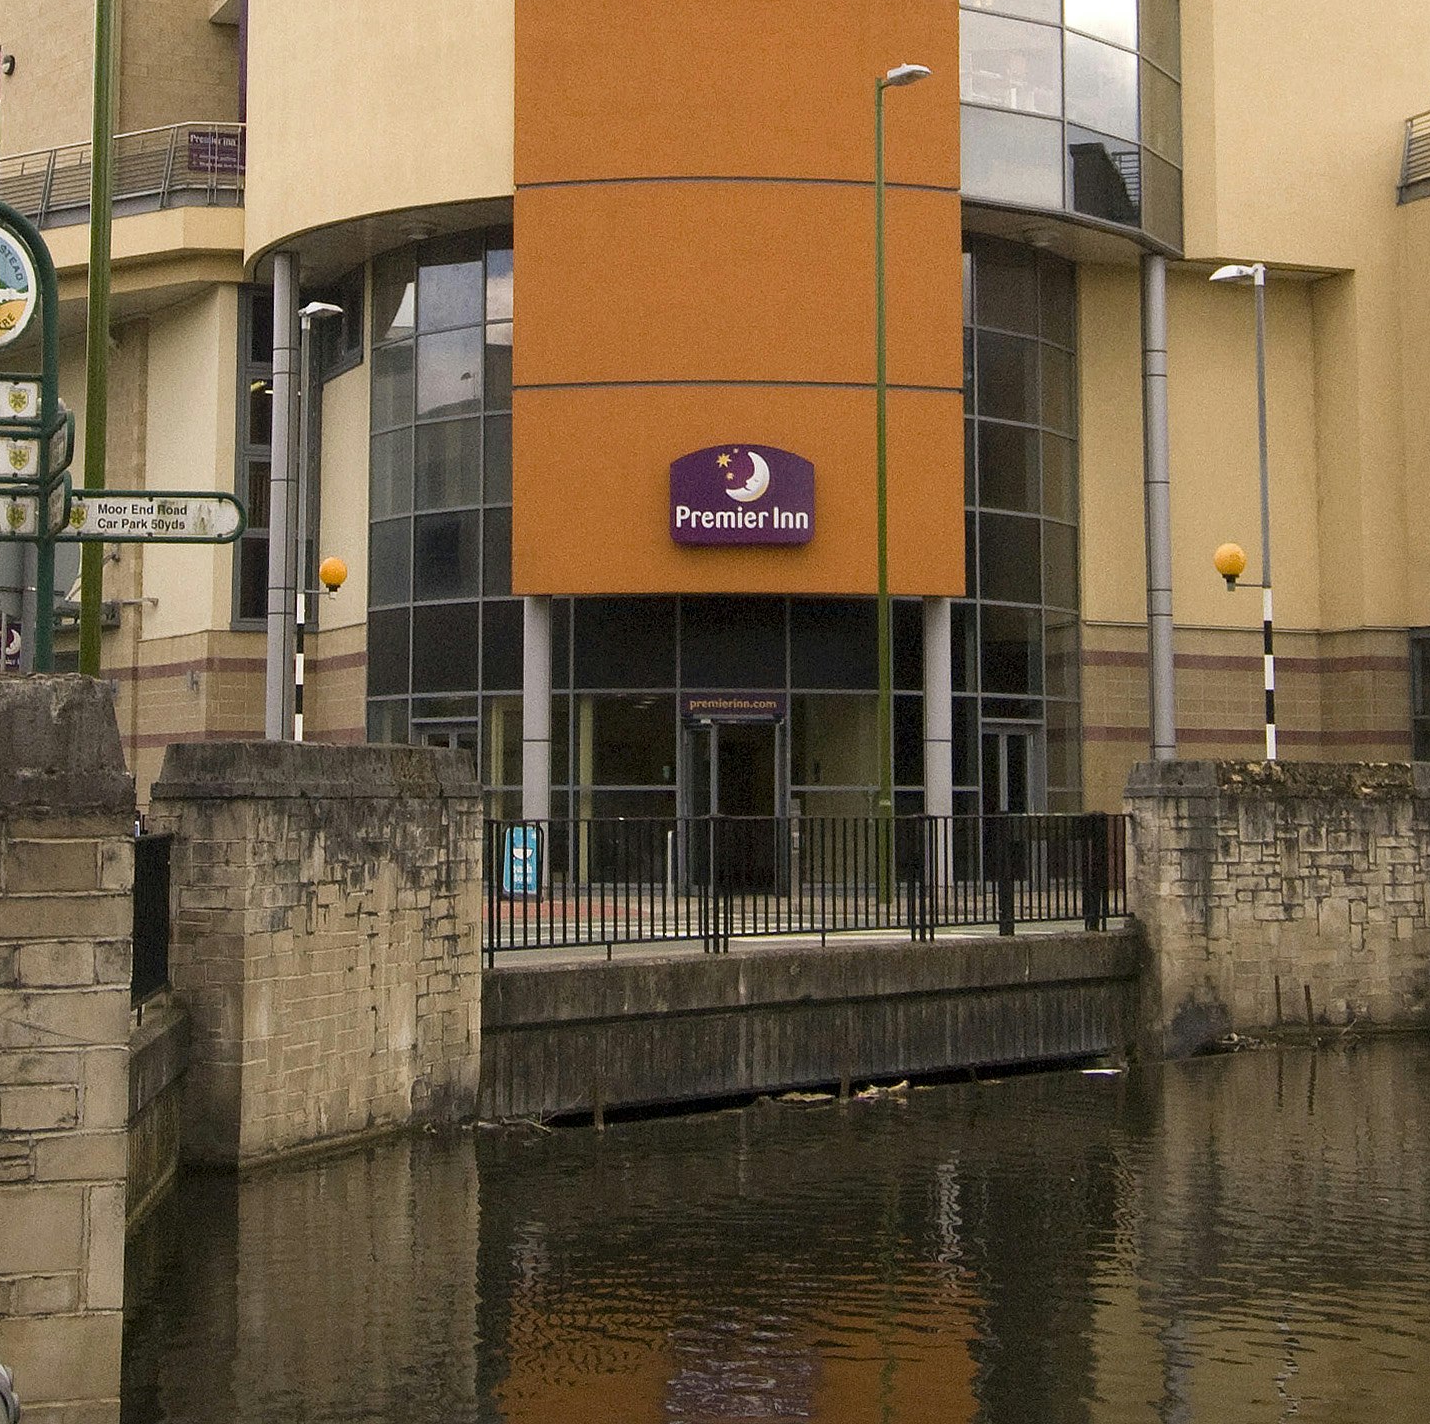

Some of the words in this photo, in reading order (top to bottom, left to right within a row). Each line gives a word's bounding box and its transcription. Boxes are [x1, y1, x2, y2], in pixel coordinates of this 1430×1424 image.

[98, 504, 127, 515] Moor
[131, 504, 154, 515] End
[157, 505, 188, 516] Road
[676, 505, 769, 529] Premier
[773, 506, 809, 529] Inn
[98, 518, 118, 529] Car
[122, 519, 148, 529] Park
[151, 519, 186, 531] 50yds
[689, 698, 777, 710] premierinn.com
